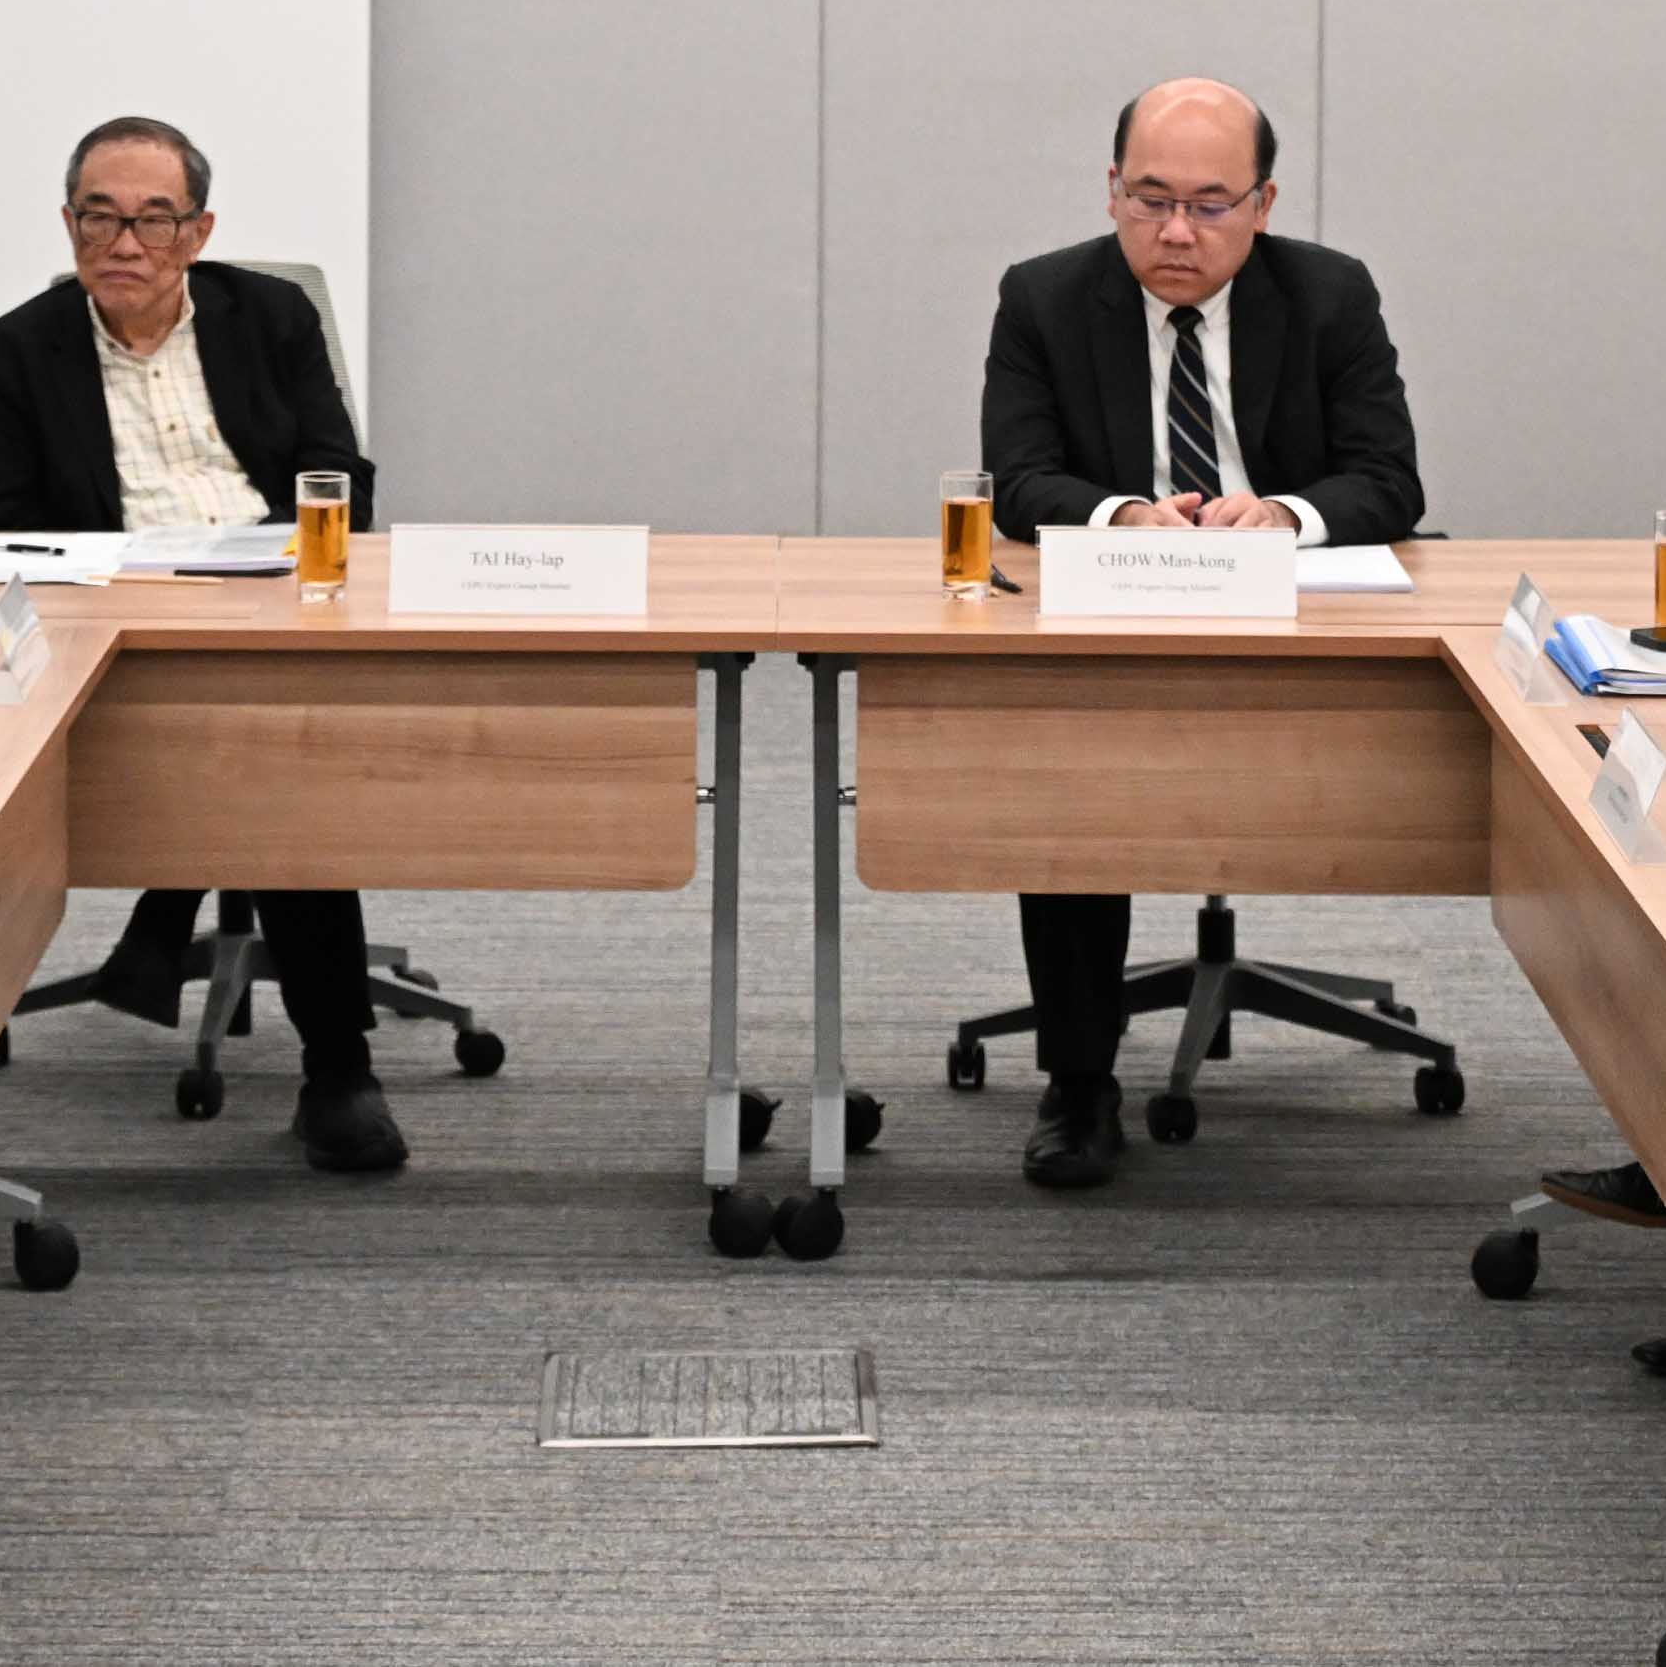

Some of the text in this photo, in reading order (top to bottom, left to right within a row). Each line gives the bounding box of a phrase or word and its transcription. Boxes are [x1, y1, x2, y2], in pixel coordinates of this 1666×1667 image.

[470, 550, 564, 570] TAI Hay-lap
[1097, 553, 1236, 572] CHOW Man-kong
